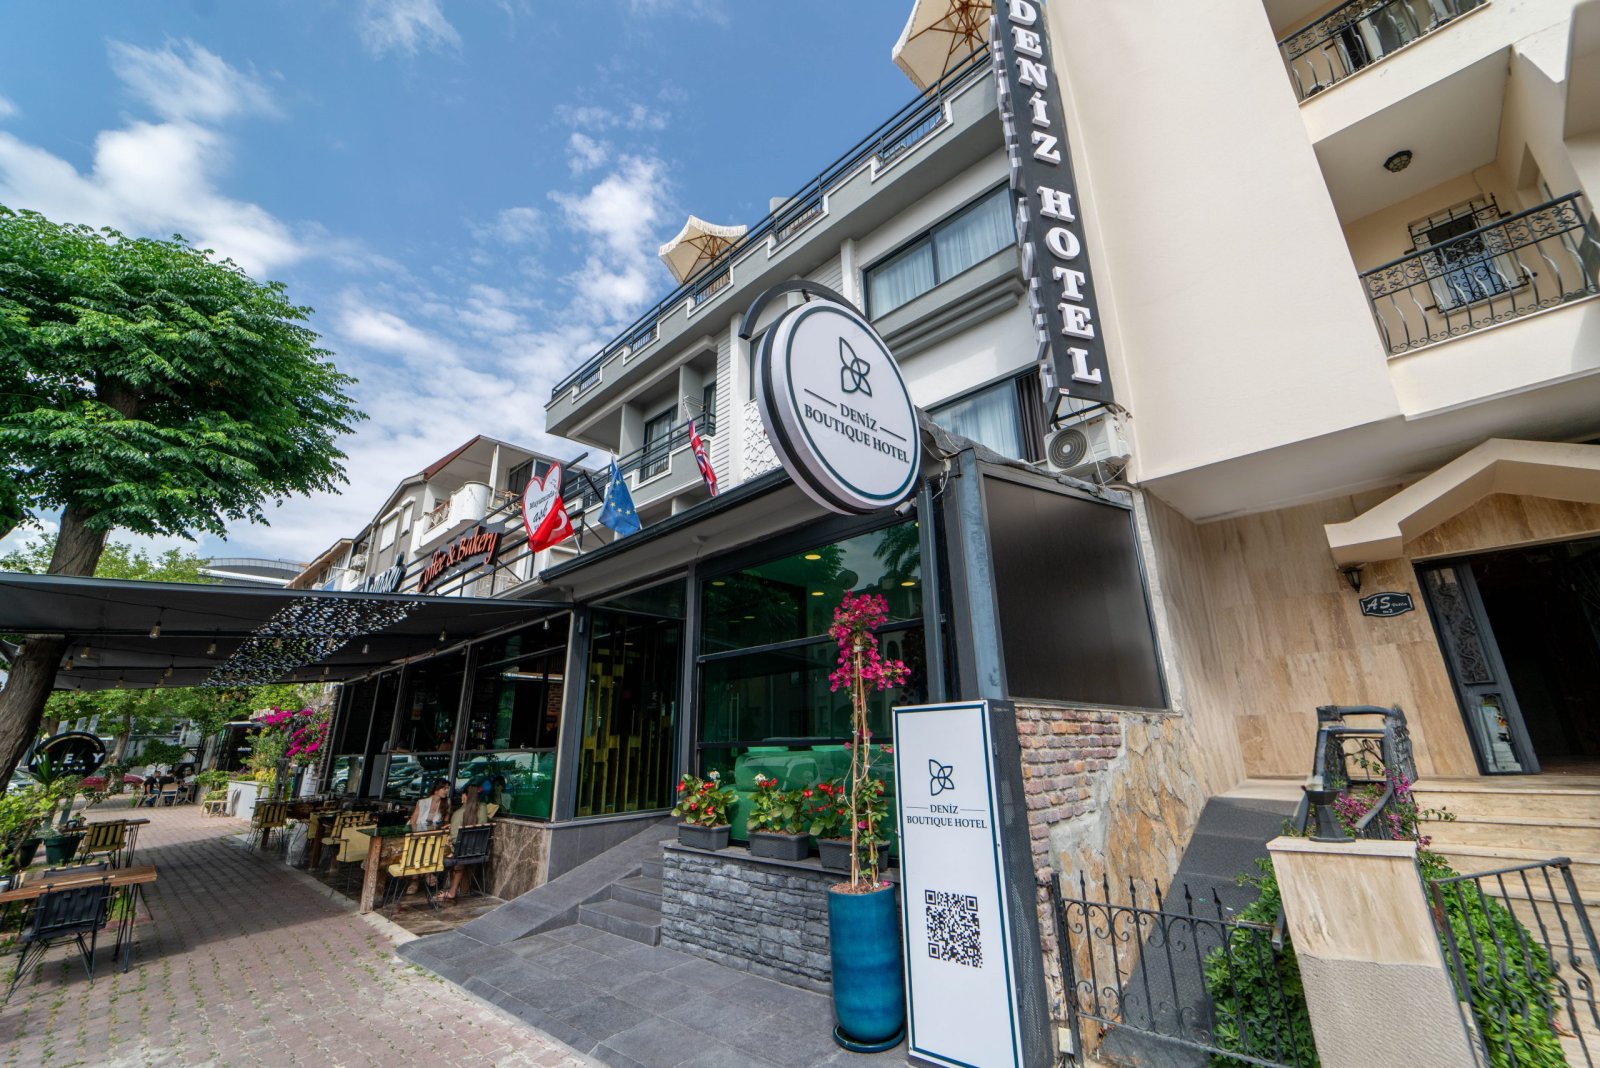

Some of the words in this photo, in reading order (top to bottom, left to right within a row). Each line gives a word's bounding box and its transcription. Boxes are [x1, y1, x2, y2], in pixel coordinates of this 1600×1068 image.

[1008, 0, 1061, 165] DENİZ
[1037, 185, 1102, 384] HOTEL
[804, 403, 870, 447] BOUTIQUE
[872, 436, 910, 464] HOTEL
[840, 402, 878, 432] DENİZ
[417, 549, 446, 592] Coffee
[446, 544, 456, 567] &
[457, 525, 498, 565] Bakery
[906, 816, 953, 827] BOUTIQUE
[954, 818, 987, 828] HOTEL
[929, 804, 959, 814] DENİZ
